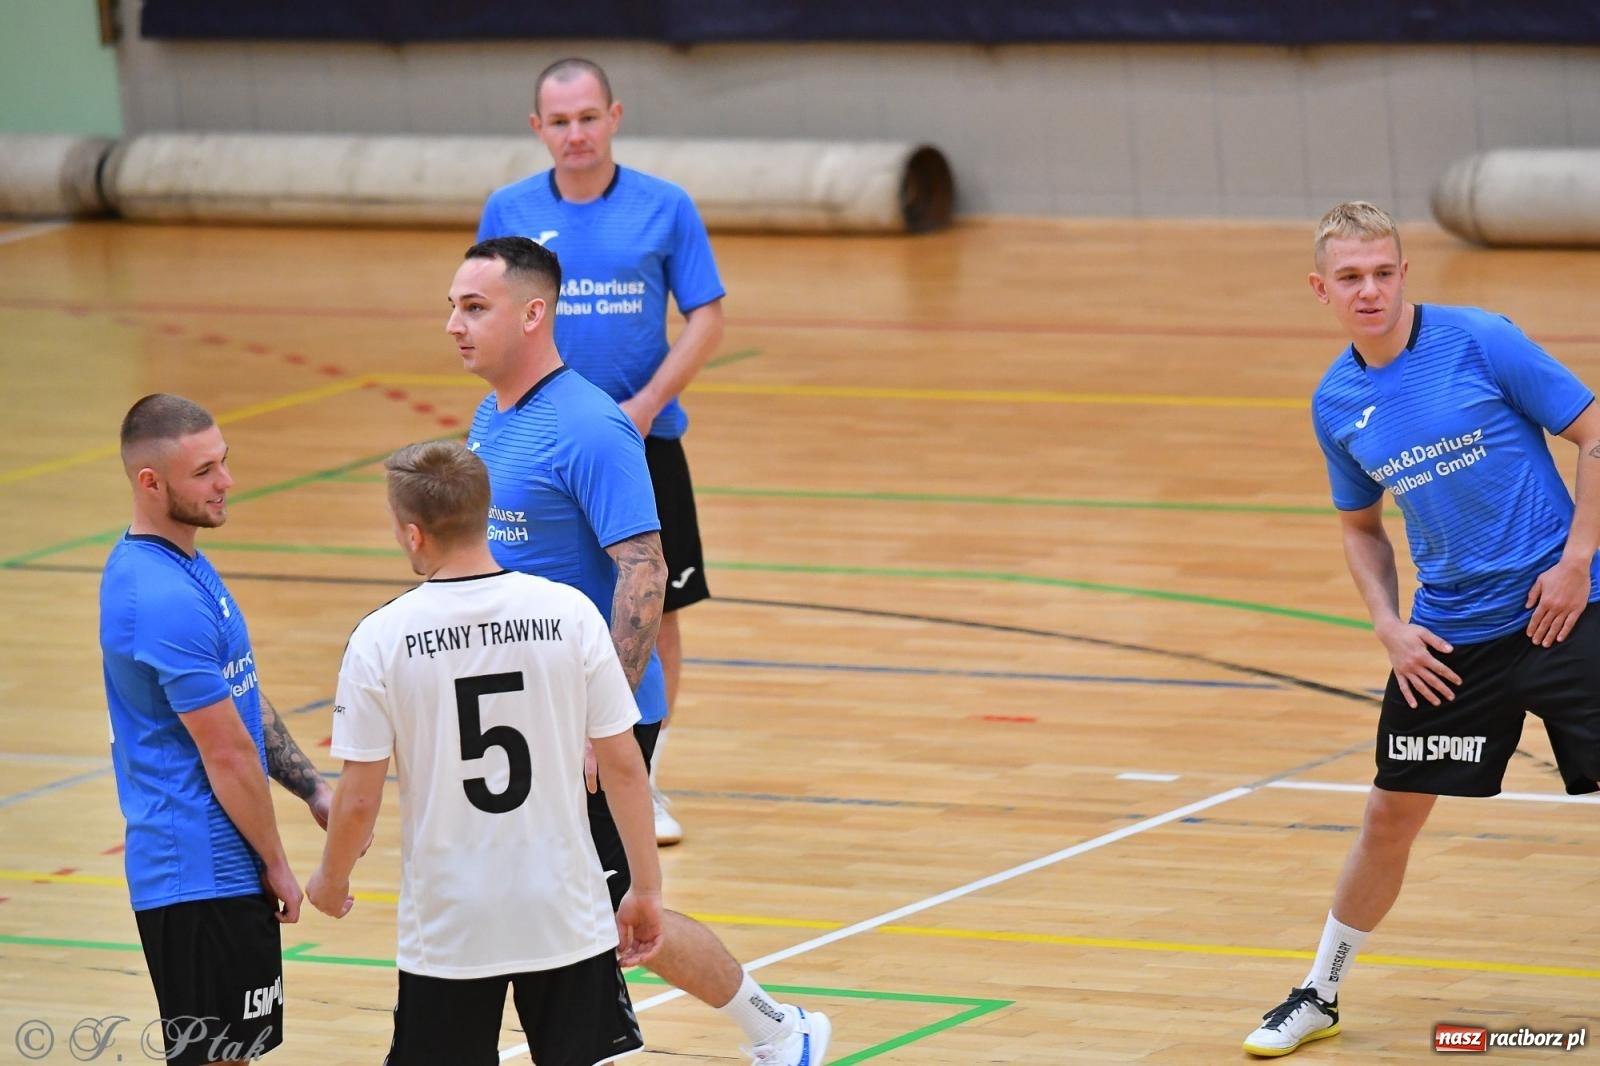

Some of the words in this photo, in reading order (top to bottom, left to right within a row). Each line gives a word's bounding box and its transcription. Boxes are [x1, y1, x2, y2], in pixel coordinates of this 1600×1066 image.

[595, 299, 643, 315] GmbH
[1366, 428, 1484, 482] arek&Dariusz
[1435, 445, 1487, 477] GmbH
[487, 525, 529, 542] GmbH
[405, 624, 472, 659] PIĘKNY
[477, 618, 563, 647] TRAWNIK
[454, 671, 533, 815] 5
[1388, 733, 1424, 761] LSM
[1426, 735, 1487, 763] SPORT
[243, 985, 275, 1020] LSM
